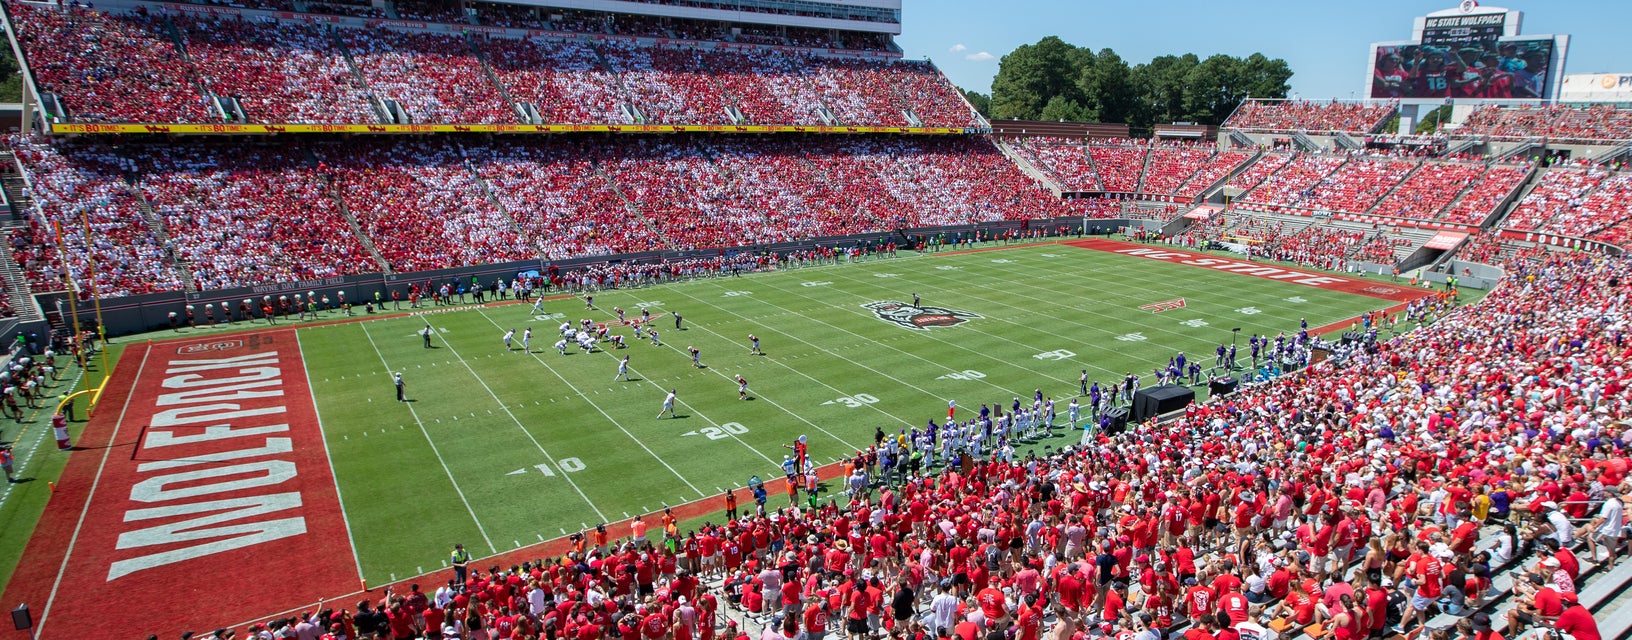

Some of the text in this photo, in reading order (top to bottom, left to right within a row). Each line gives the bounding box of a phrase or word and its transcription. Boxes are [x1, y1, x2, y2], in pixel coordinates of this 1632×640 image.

[179, 5, 211, 14] RUSSELL
[1426, 14, 1504, 28] NC STATE WOLFPACK
[1427, 77, 1447, 90] 18
[86, 124, 98, 132] BO
[214, 124, 225, 132] BO
[1117, 248, 1349, 286] NC STATE
[253, 283, 279, 293] WAYNE
[299, 279, 324, 287] FAMILY
[836, 393, 880, 408] 30
[705, 422, 750, 441] 20
[106, 351, 307, 582] WOLFPACK
[534, 456, 587, 477] 10
